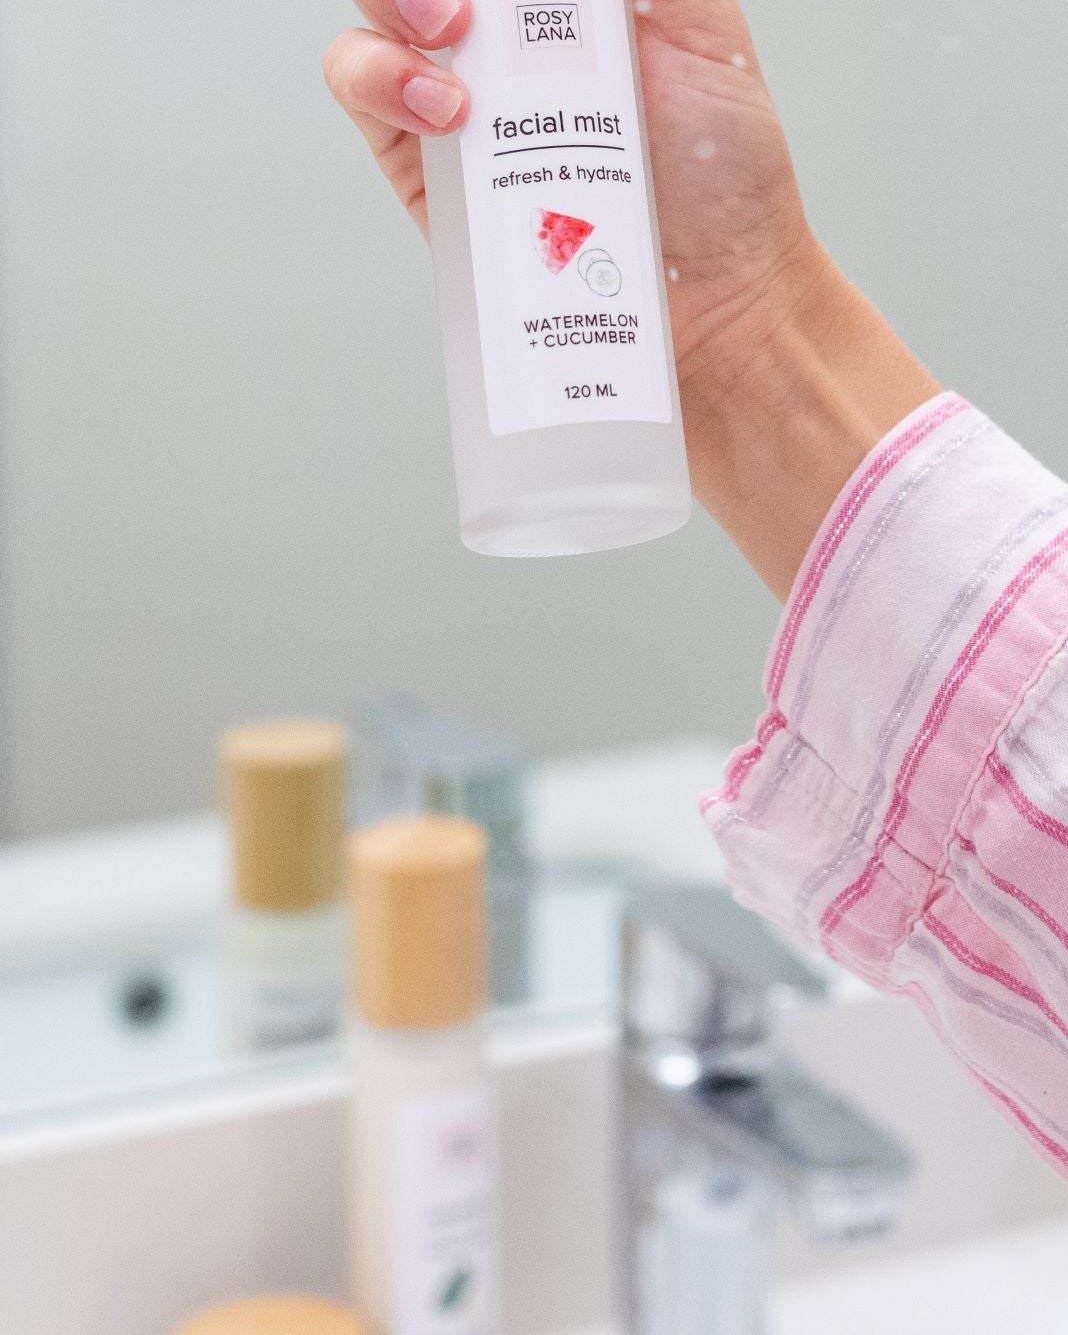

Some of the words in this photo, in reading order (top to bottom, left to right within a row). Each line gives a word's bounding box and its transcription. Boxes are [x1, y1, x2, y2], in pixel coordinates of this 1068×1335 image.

[523, 10, 573, 27] ROSY
[525, 26, 577, 43] LANA
[492, 110, 565, 141] facial
[574, 111, 622, 136] mist
[492, 167, 553, 190] refresh
[558, 165, 572, 181] &
[576, 164, 632, 184] hydrate
[523, 313, 639, 334] WATERMELON
[543, 330, 637, 348] CUCUMBER
[564, 384, 591, 399] 120
[595, 383, 618, 397] ML
